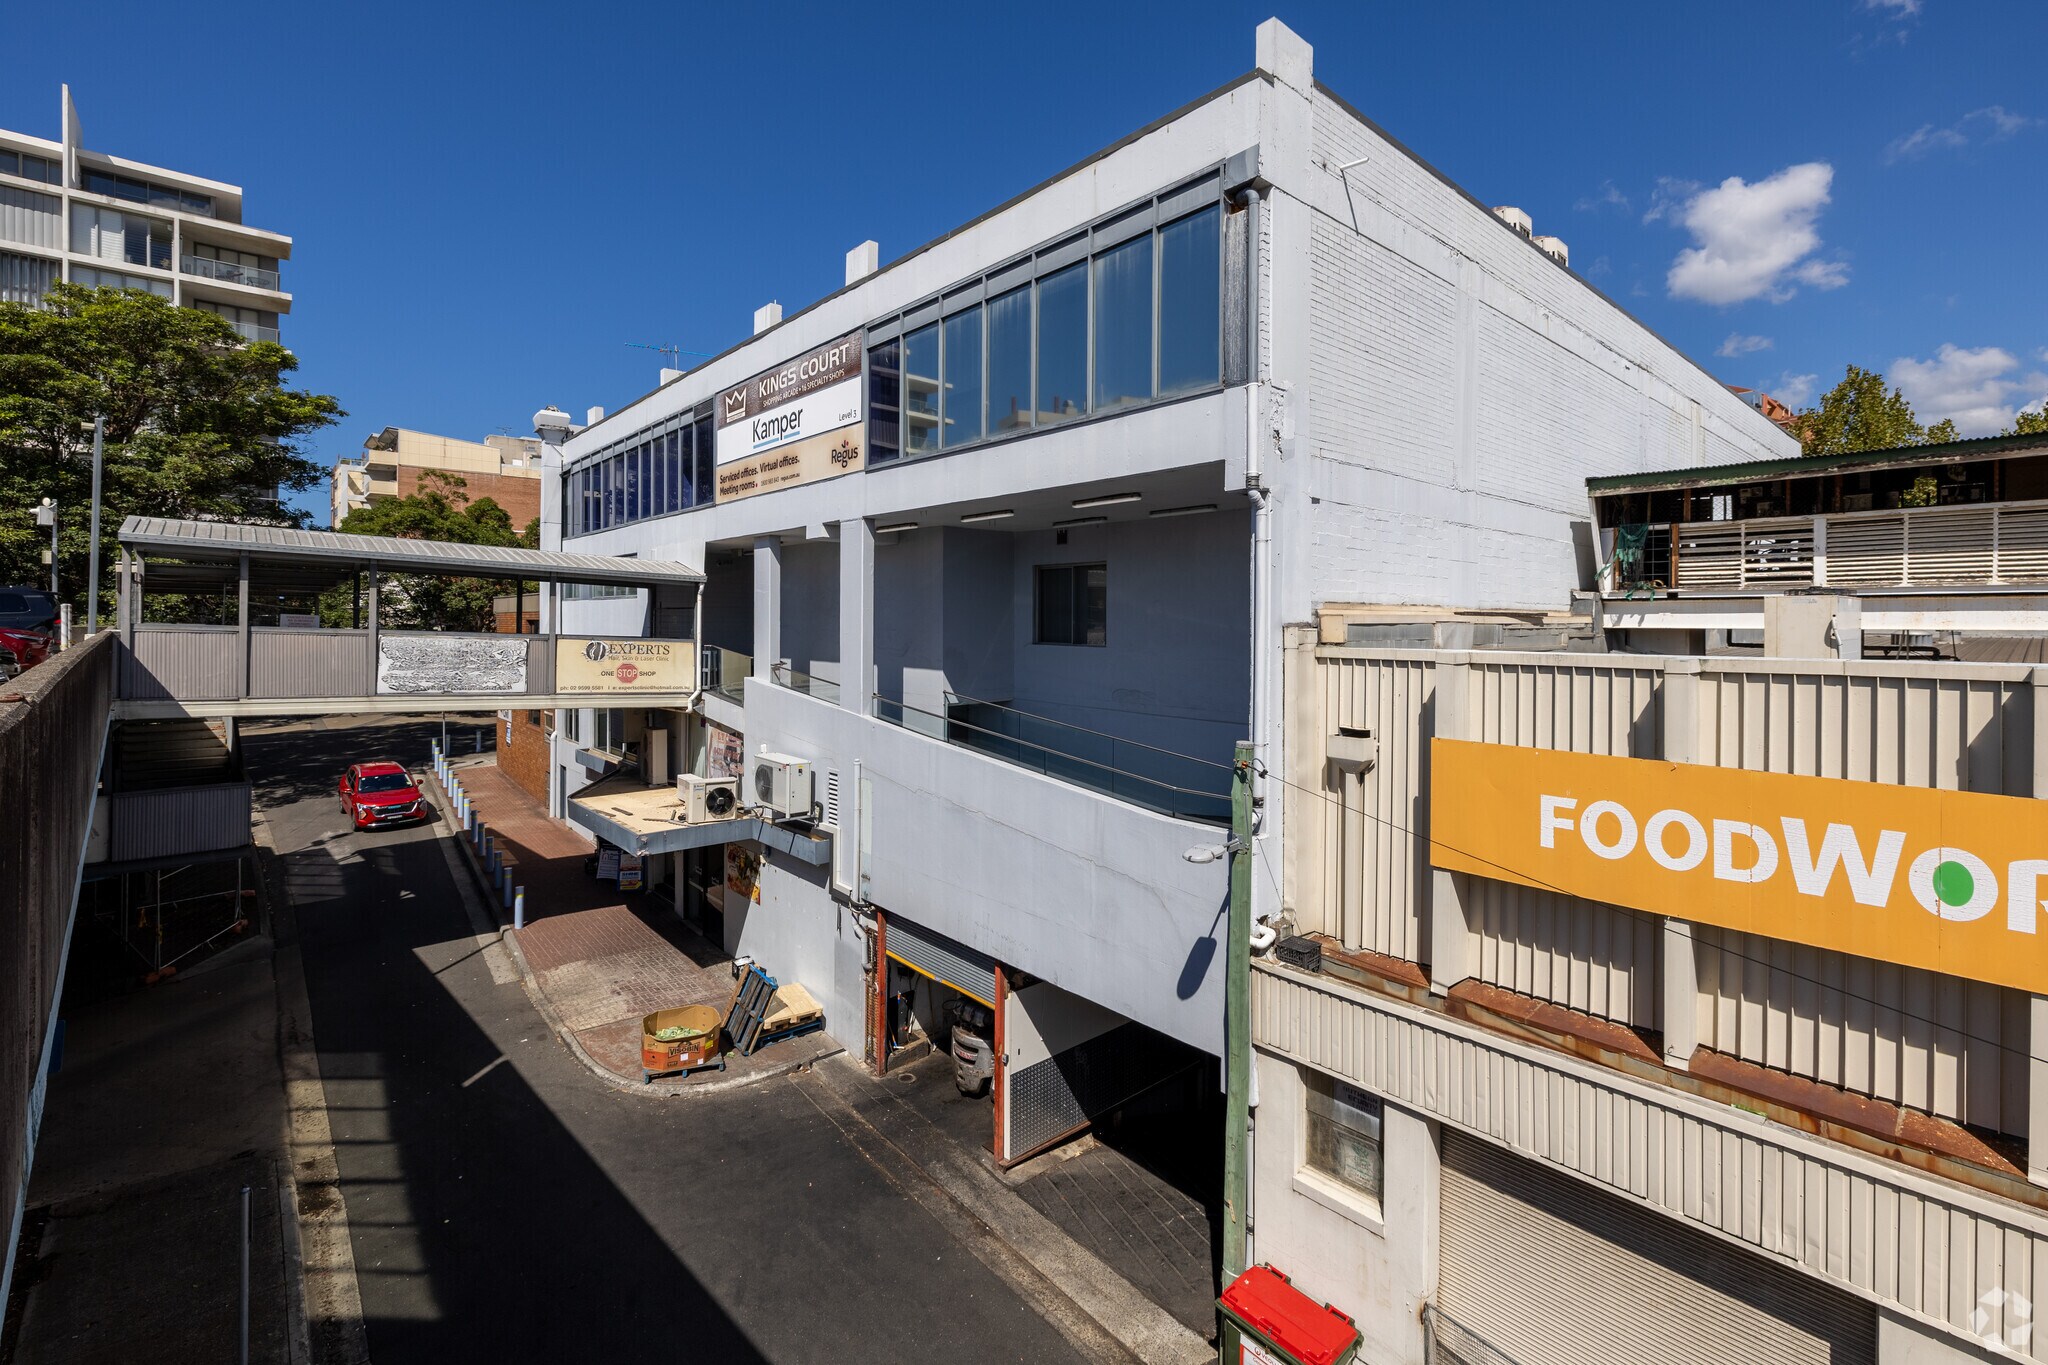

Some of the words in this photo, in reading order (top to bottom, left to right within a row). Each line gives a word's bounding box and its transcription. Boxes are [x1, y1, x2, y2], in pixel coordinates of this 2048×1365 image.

[759, 367, 797, 398] KINGS
[800, 343, 850, 380] COURT
[763, 393, 783, 408] SHOPPING
[783, 387, 799, 401] ARCADE
[807, 375, 829, 390] SPECIALTY
[829, 368, 845, 382] SHOPS
[752, 409, 803, 442] Kamper
[838, 409, 853, 421] Level
[853, 410, 857, 419] 3
[831, 447, 859, 468] Regus
[719, 470, 741, 484] Serviced
[741, 467, 759, 479] offices.
[760, 459, 778, 473] Virtual
[779, 455, 800, 468] offices.
[719, 484, 739, 496] Meeting
[609, 643, 670, 655] EXPERTS
[617, 669, 638, 678] STOP
